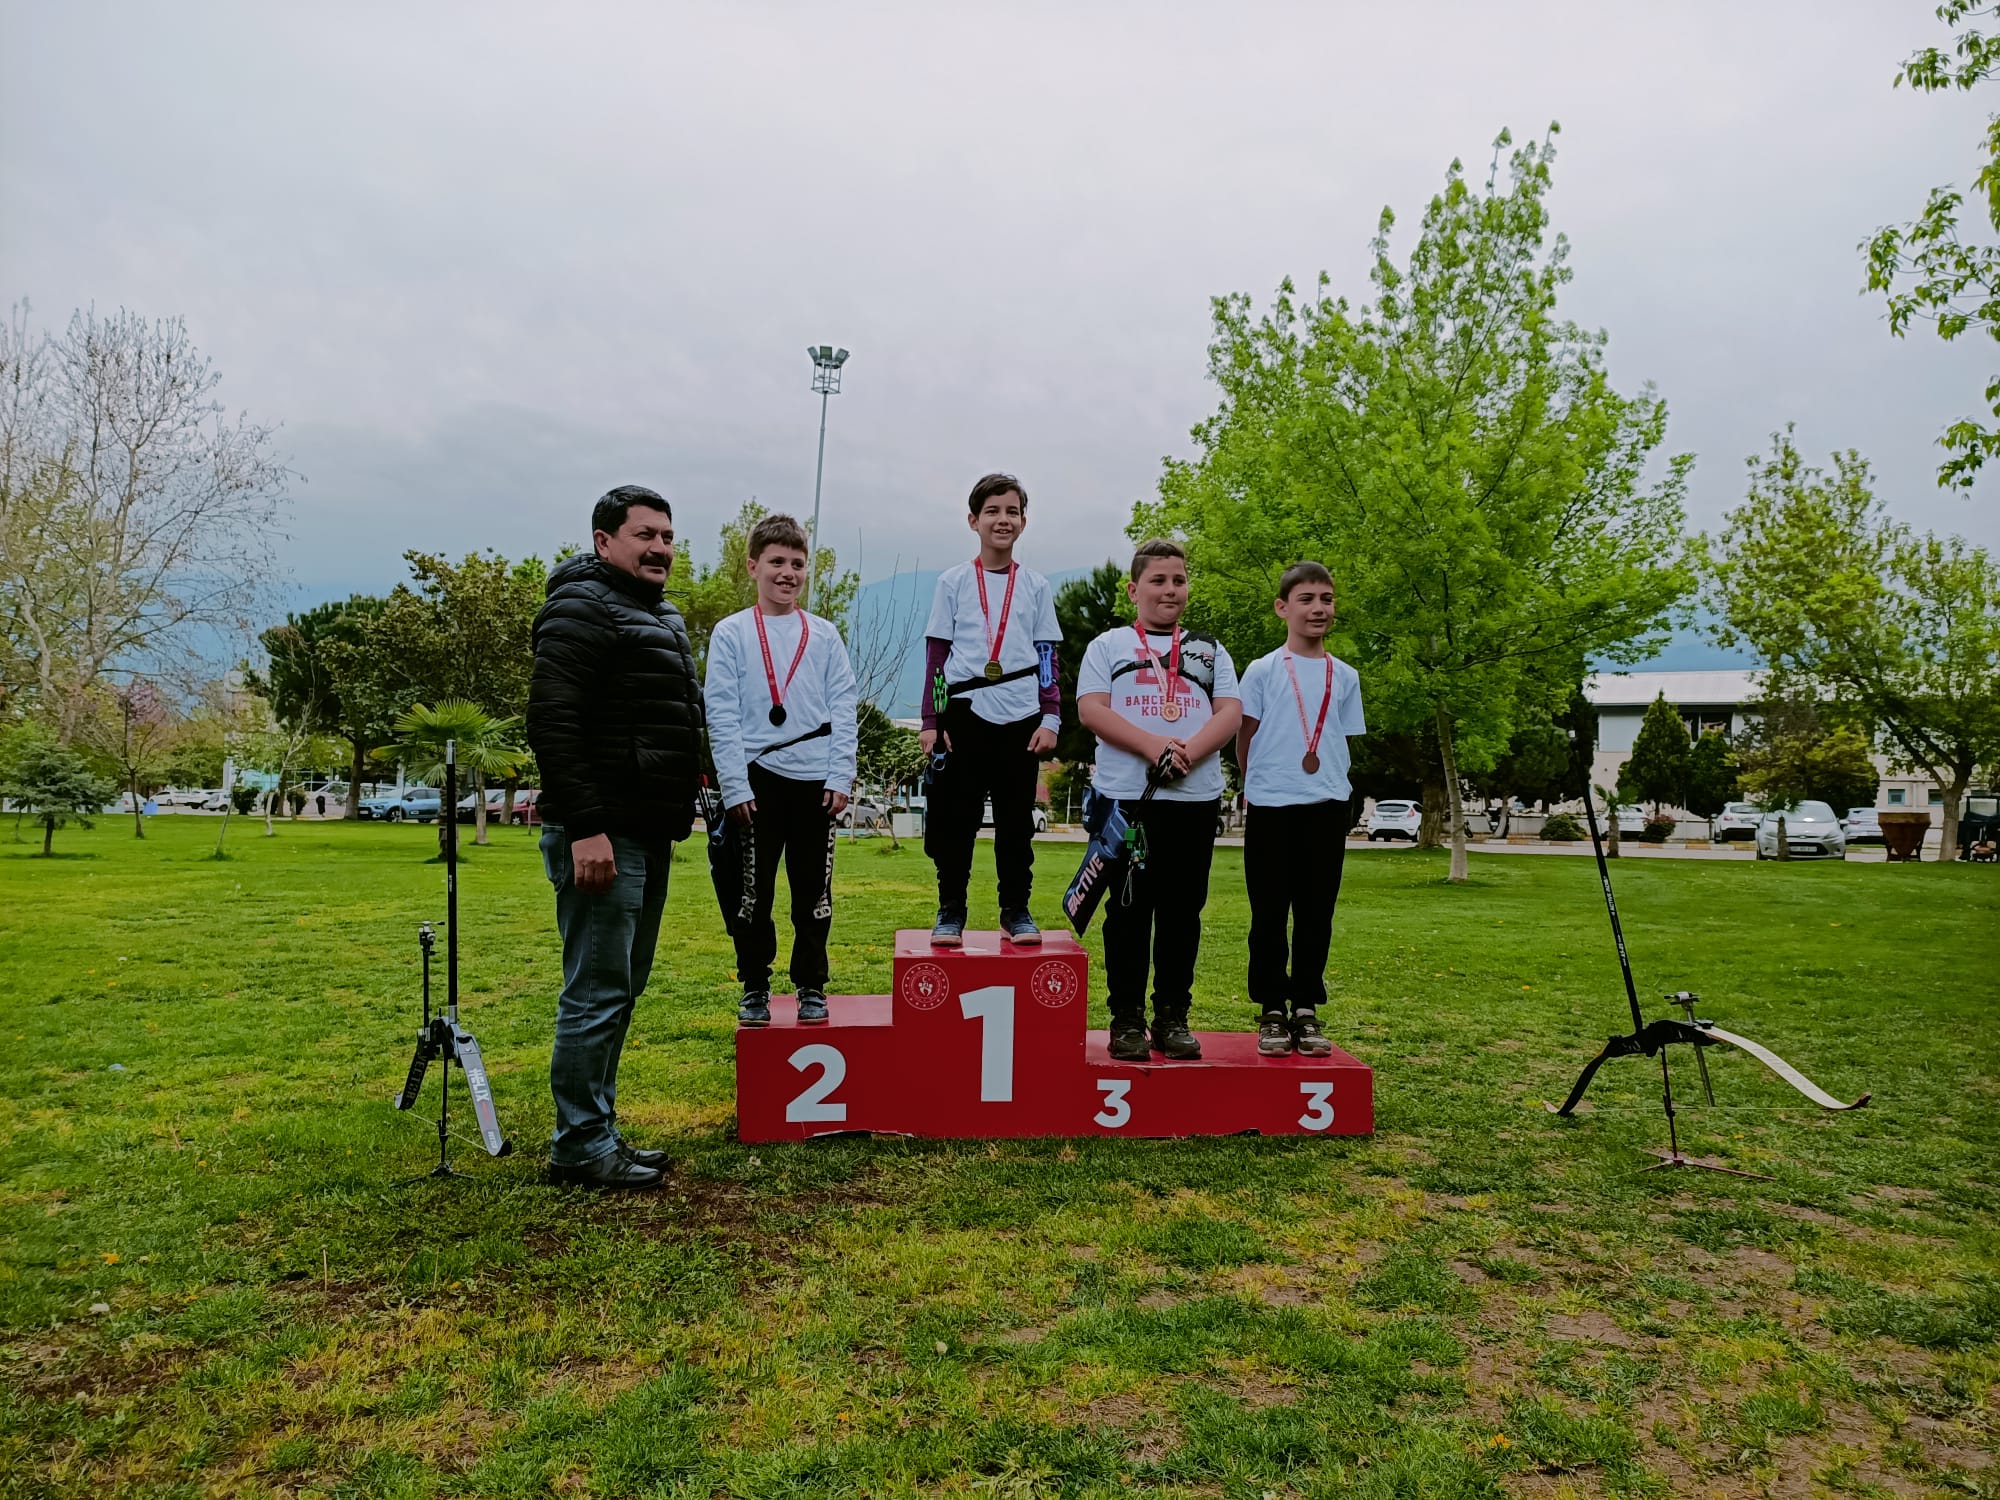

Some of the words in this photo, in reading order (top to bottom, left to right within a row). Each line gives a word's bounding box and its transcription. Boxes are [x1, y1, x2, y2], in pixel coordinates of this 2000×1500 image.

[958, 986, 1015, 1103] 1
[785, 1043, 847, 1122] 2
[1093, 1079, 1132, 1129] 3
[1298, 1082, 1335, 1131] 3
